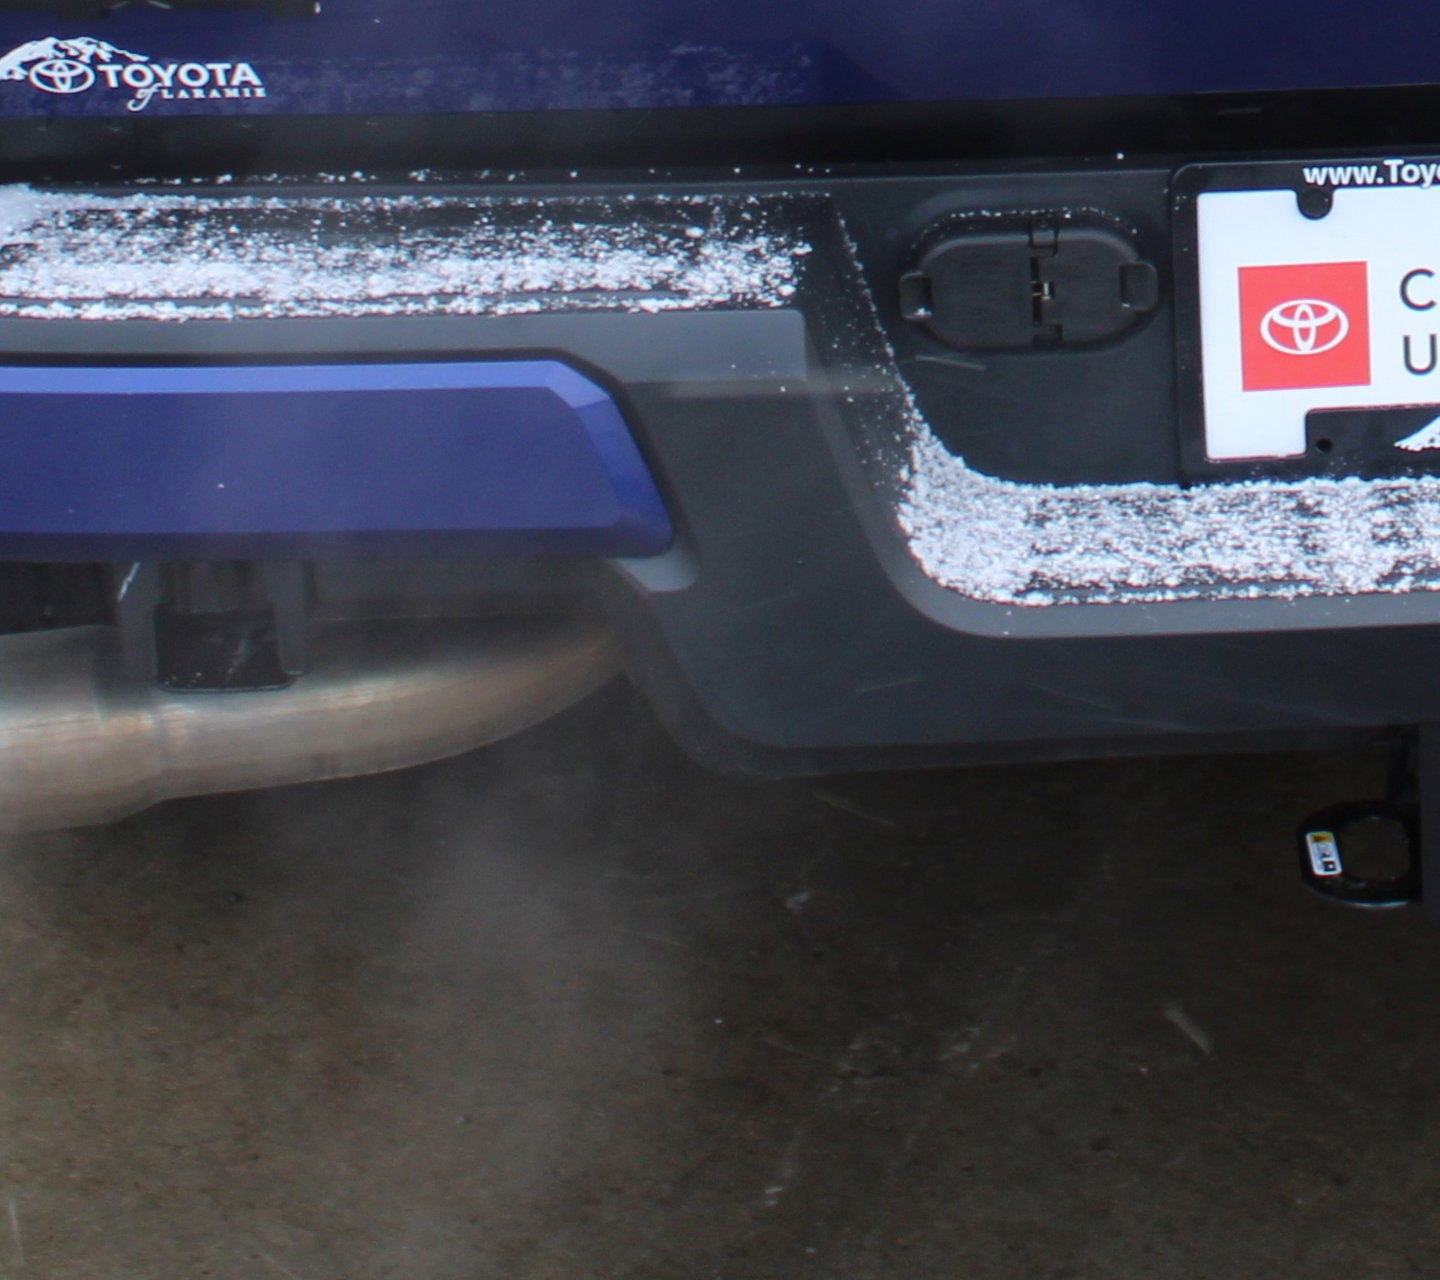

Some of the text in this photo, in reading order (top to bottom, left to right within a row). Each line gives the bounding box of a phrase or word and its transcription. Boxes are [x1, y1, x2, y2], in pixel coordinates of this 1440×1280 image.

[97, 62, 263, 88] TOYOTA
[126, 83, 267, 112] of LARAMIE
